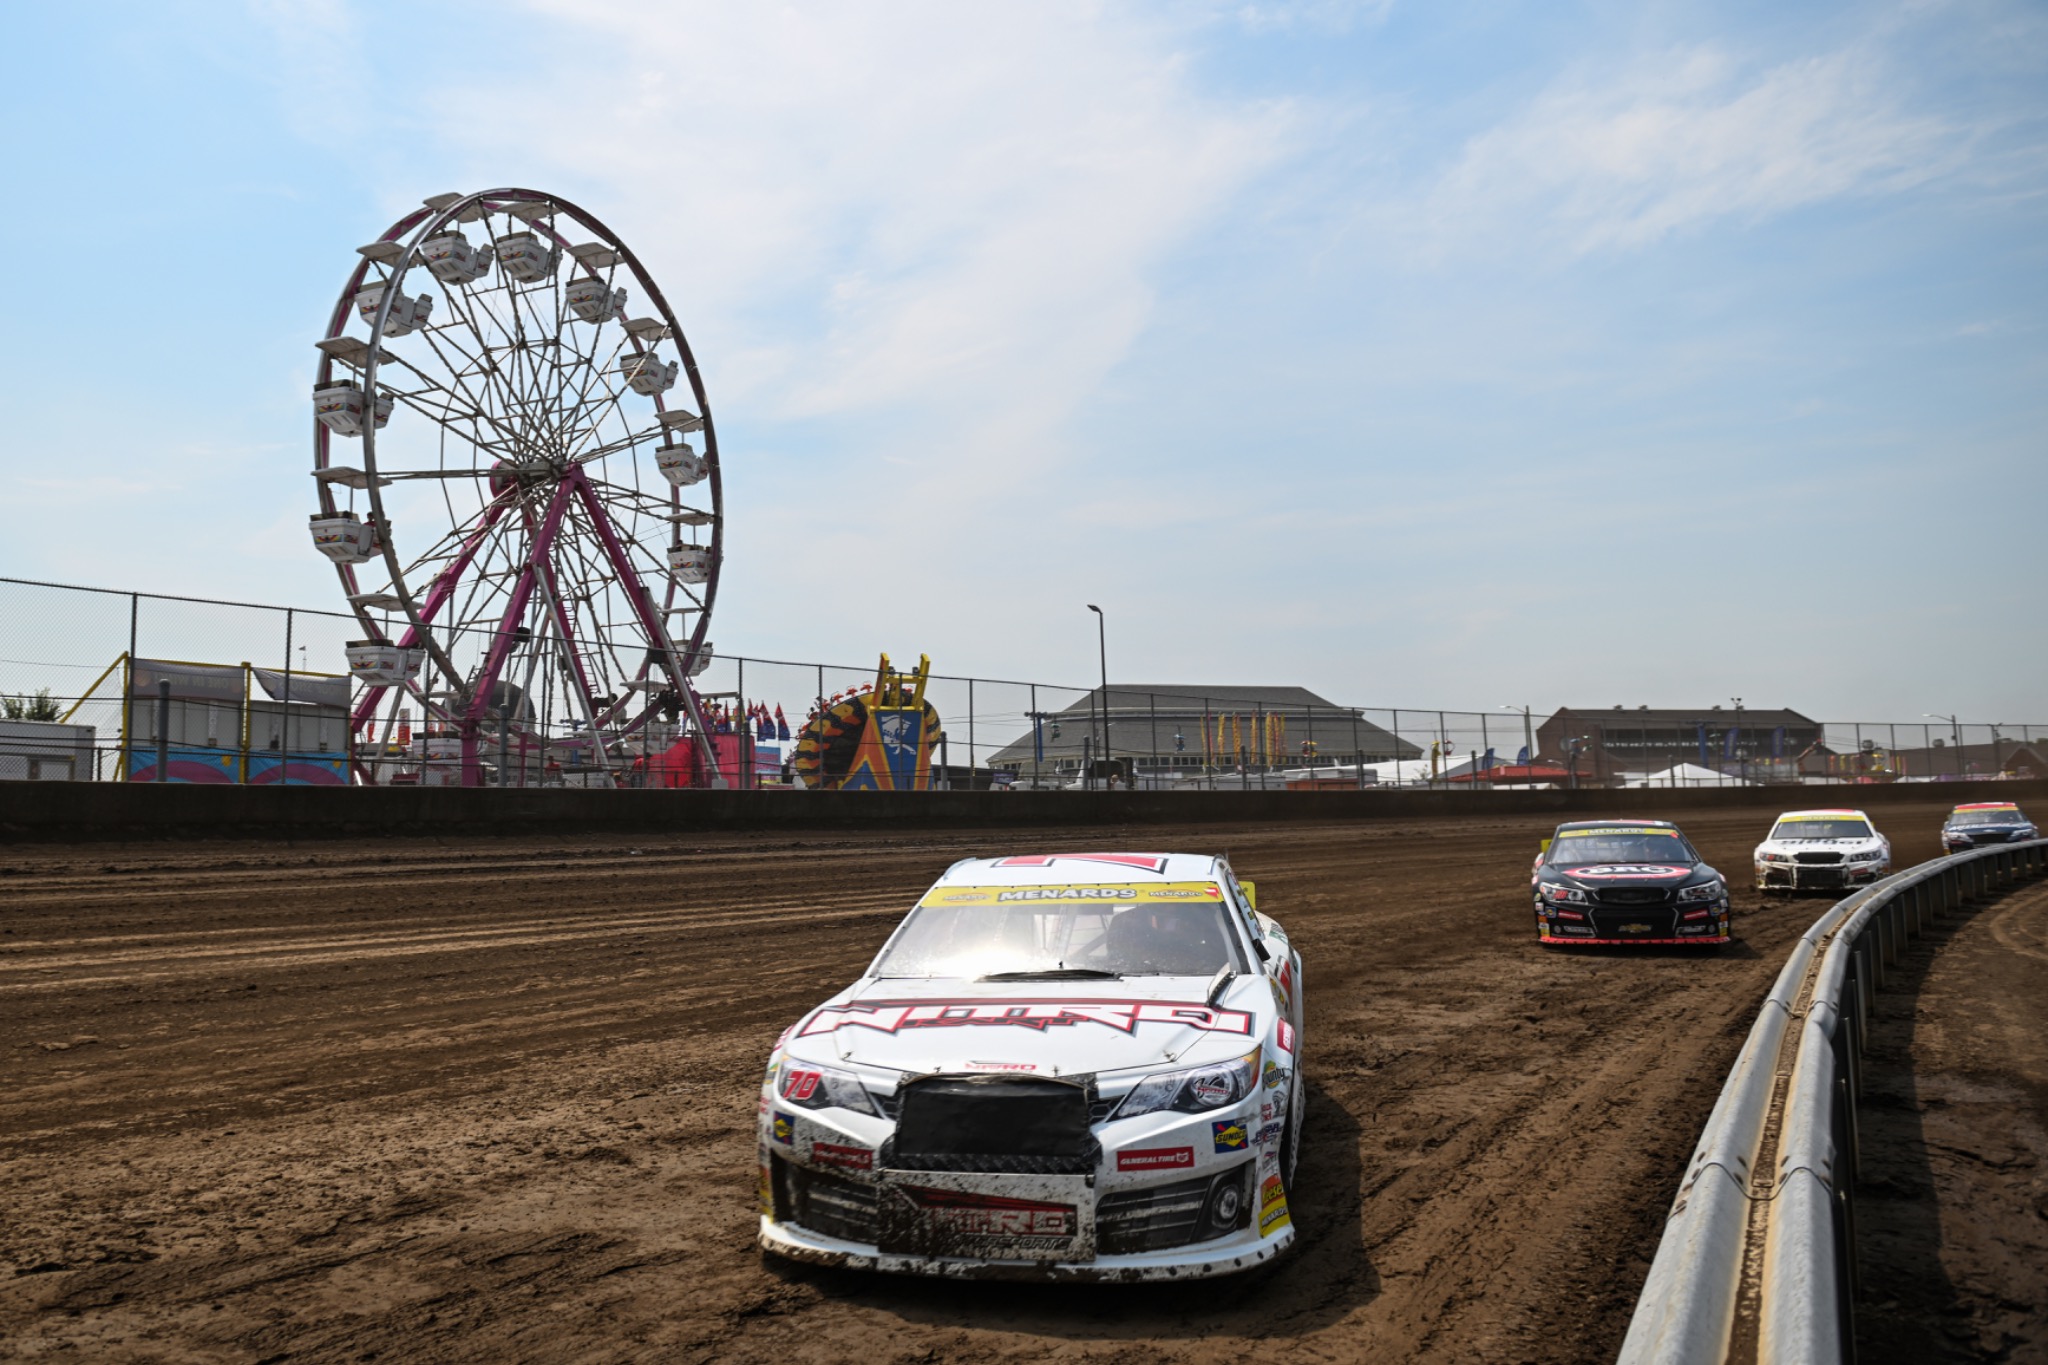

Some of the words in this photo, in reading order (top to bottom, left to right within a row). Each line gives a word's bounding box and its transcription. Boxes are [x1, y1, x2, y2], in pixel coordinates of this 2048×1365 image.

[997, 888, 1137, 902] MENARDS
[783, 1070, 822, 1100] 70
[1215, 1130, 1247, 1143] SUNOCO
